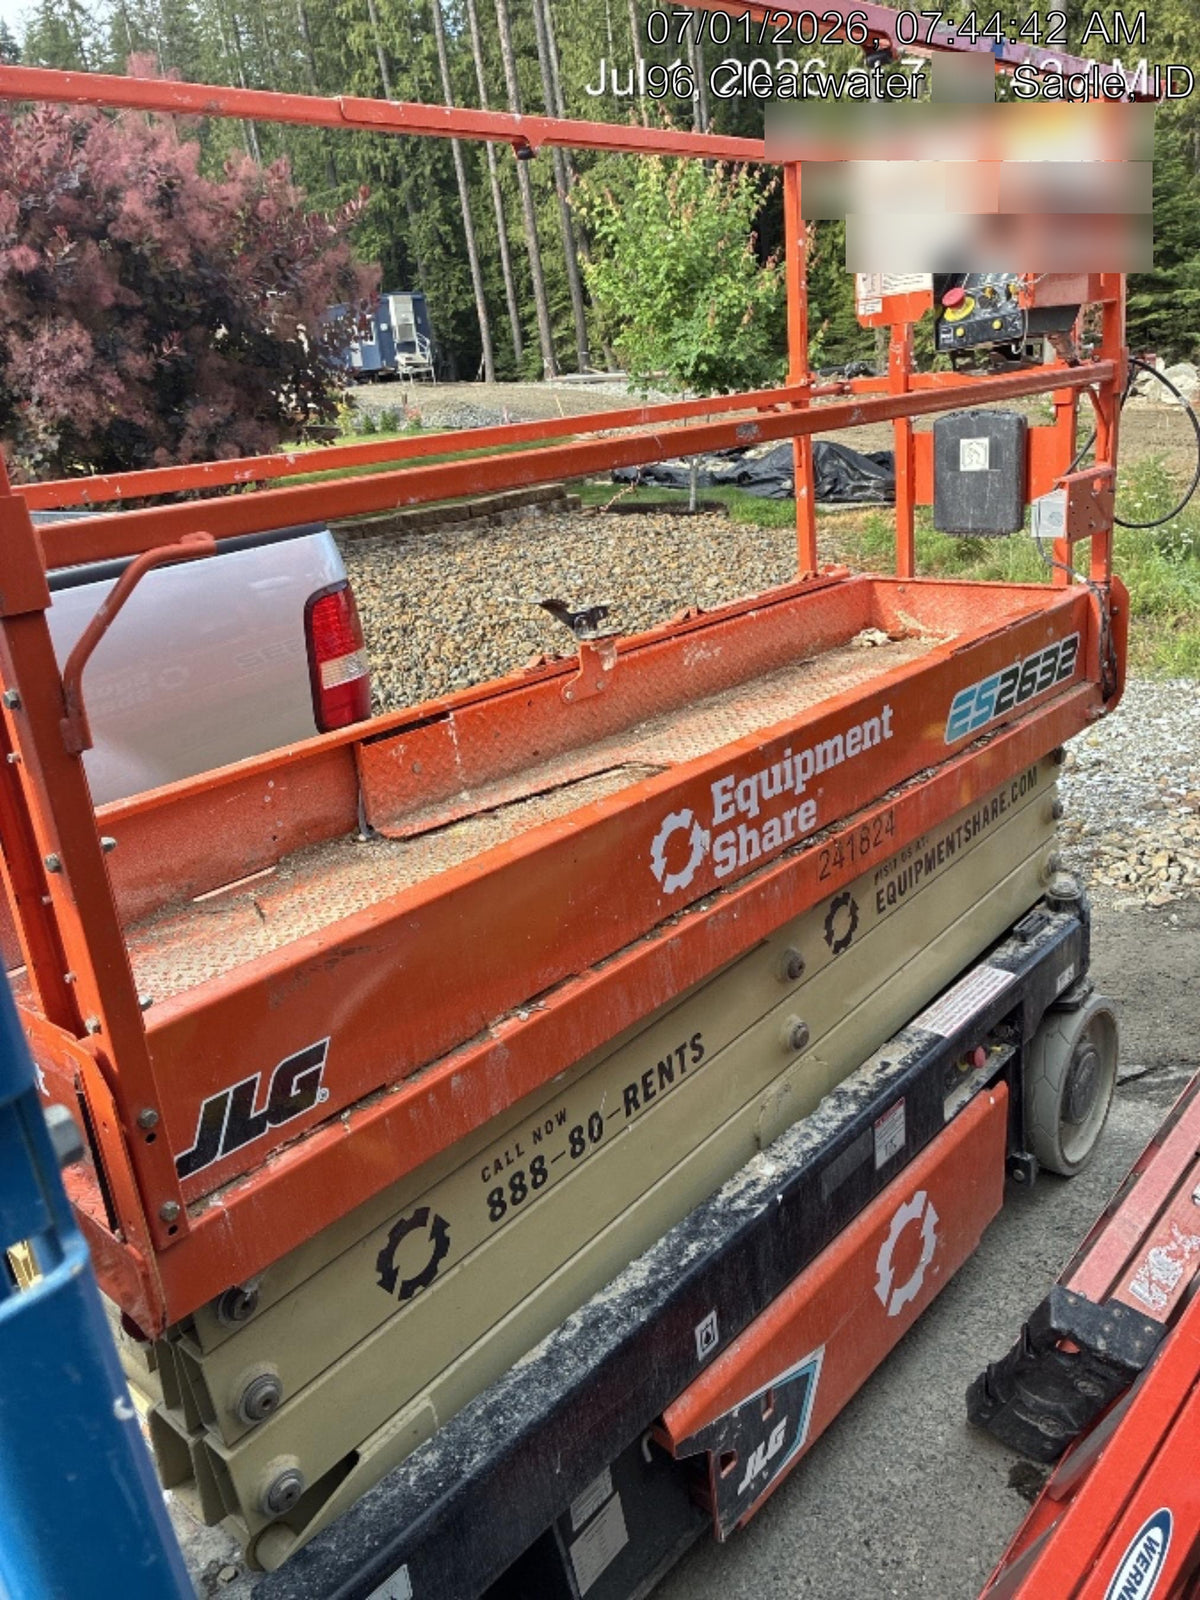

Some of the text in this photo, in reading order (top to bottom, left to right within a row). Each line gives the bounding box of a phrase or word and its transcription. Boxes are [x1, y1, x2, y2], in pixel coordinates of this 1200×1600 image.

[944, 631, 1080, 745] ES2632
[710, 704, 893, 826] Equipment
[712, 798, 817, 879] Share
[818, 809, 896, 882] 241824
[875, 765, 1039, 915] EQUIPMENTSHARE.COM
[174, 1036, 331, 1182] JLG
[481, 1106, 568, 1184] CALL NOW
[485, 1031, 706, 1223] 888-80-RENTS
[737, 1415, 788, 1496] JLG
